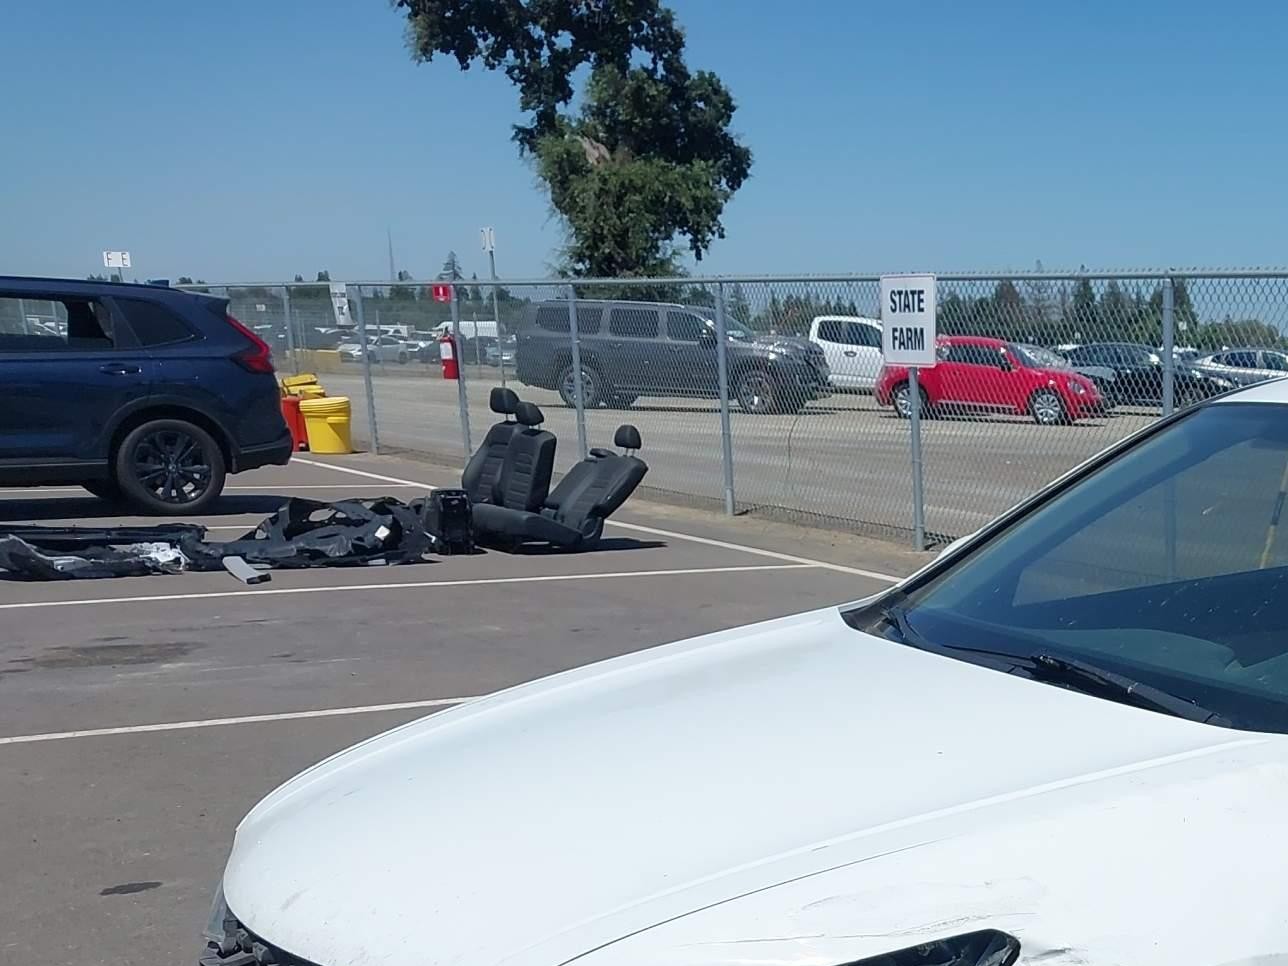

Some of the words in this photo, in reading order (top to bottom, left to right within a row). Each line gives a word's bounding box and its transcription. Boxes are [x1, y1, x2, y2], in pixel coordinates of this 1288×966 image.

[120, 252, 129, 267] E
[889, 289, 925, 314] STATE
[891, 326, 925, 351] FARM
